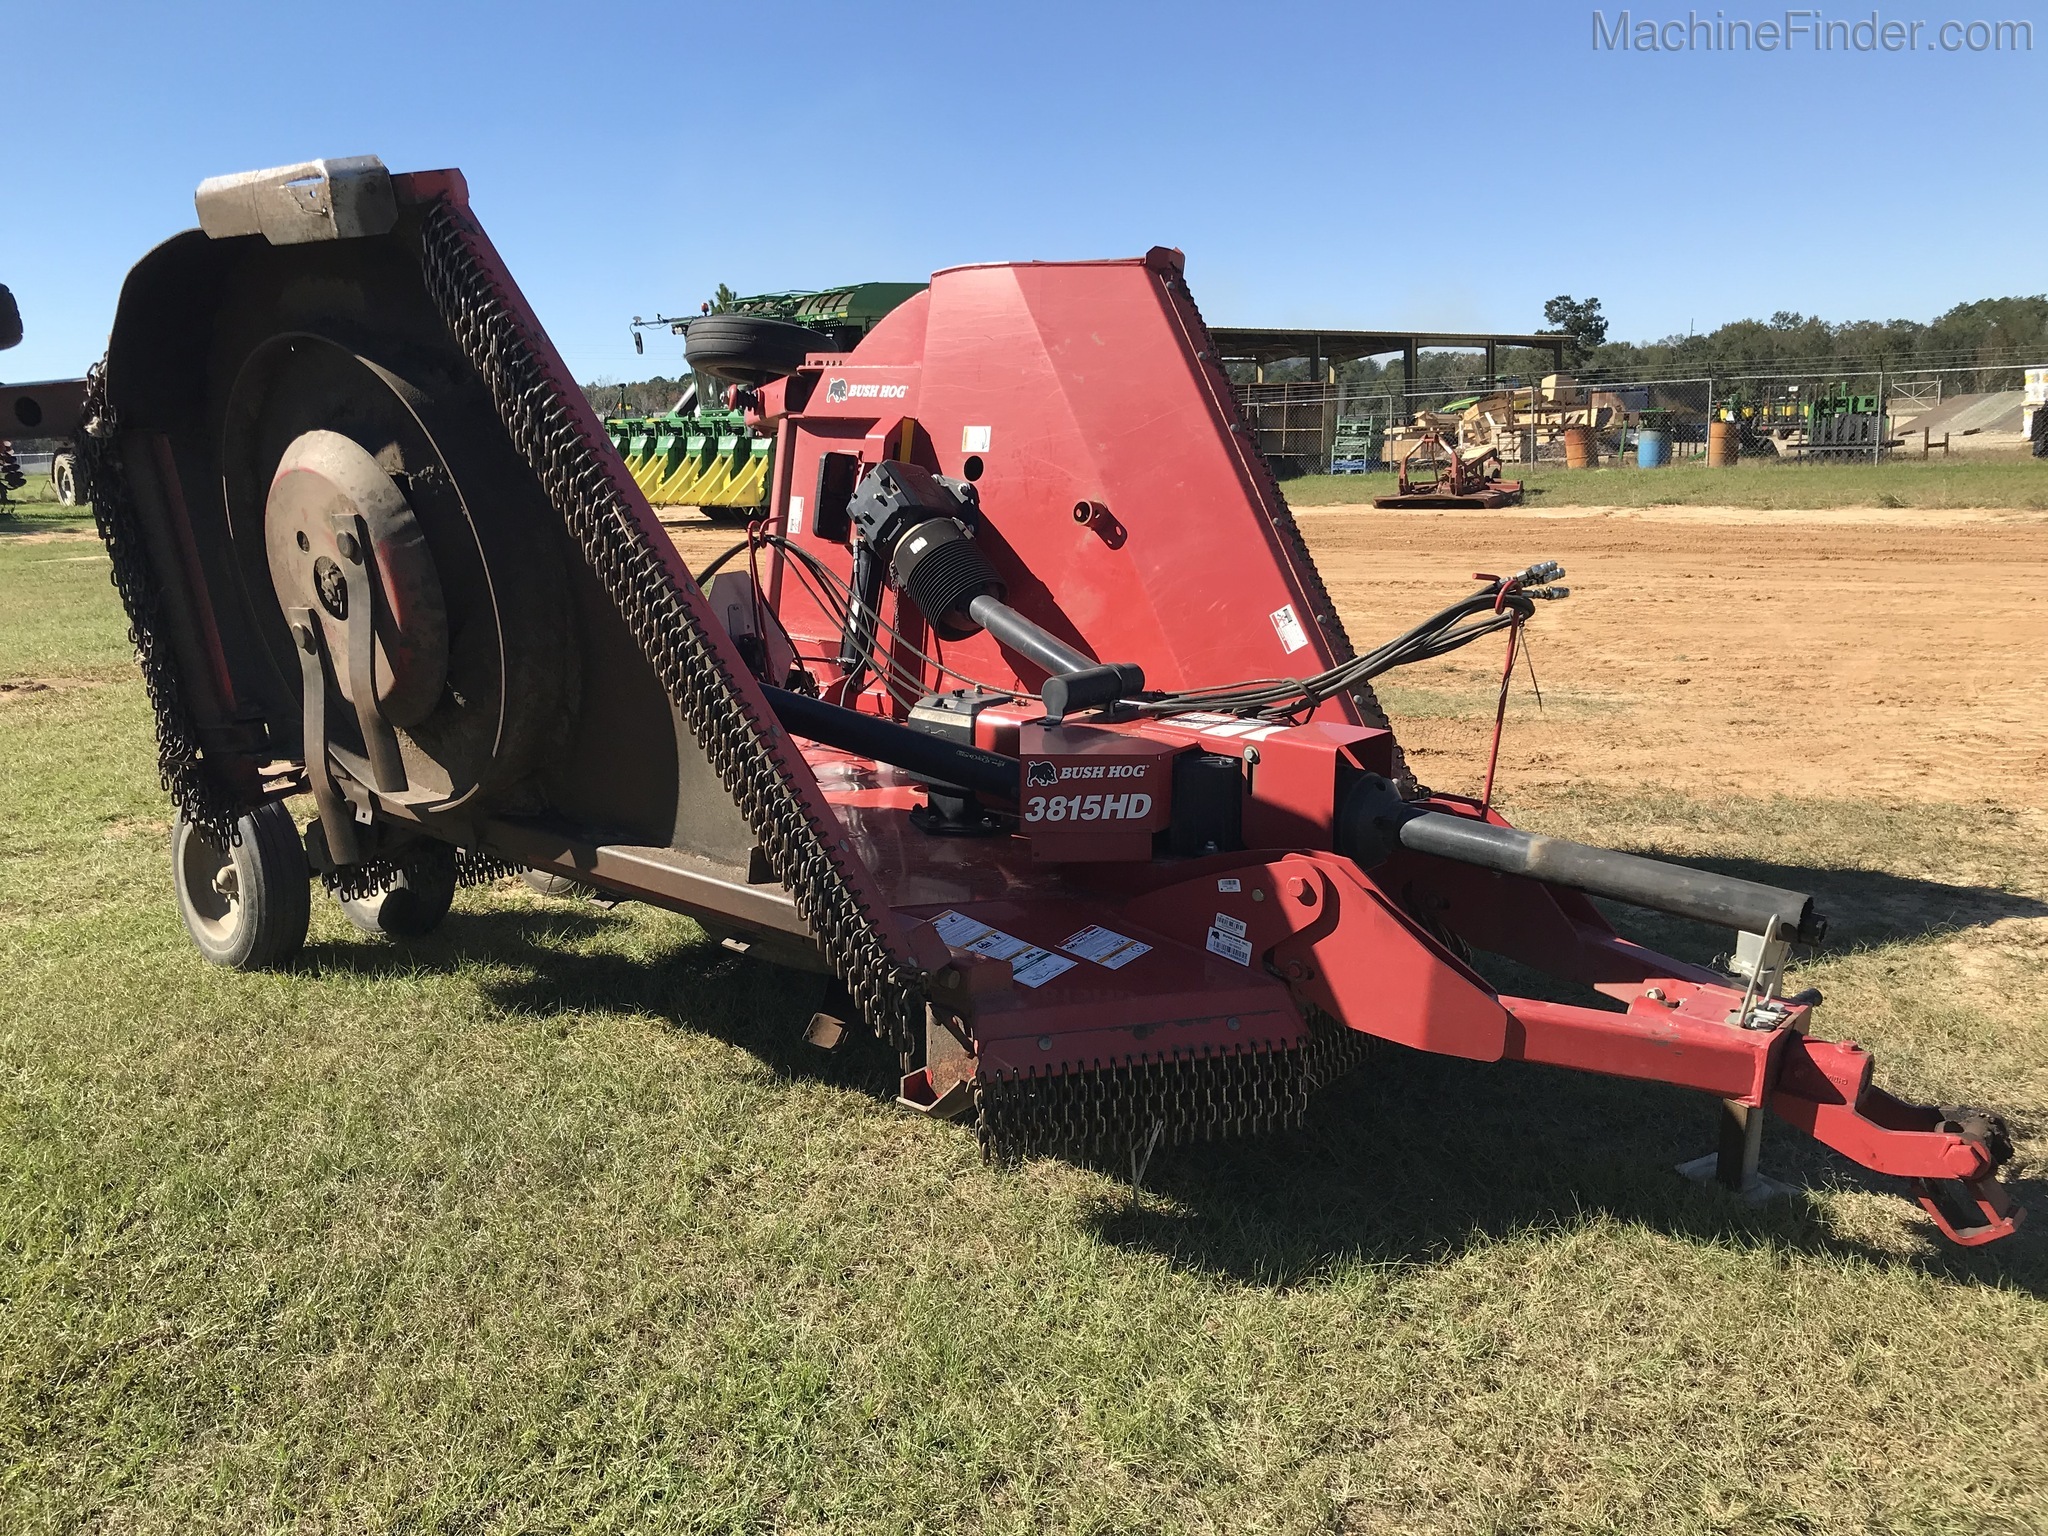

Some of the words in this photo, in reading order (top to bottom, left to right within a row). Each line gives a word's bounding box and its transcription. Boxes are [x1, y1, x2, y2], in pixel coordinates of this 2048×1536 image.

[848, 384, 879, 398] BUSH
[879, 385, 907, 399] HOG
[1060, 766, 1105, 780] BUSH
[1107, 765, 1146, 778] HOG
[1024, 793, 1153, 822] 3815HD
